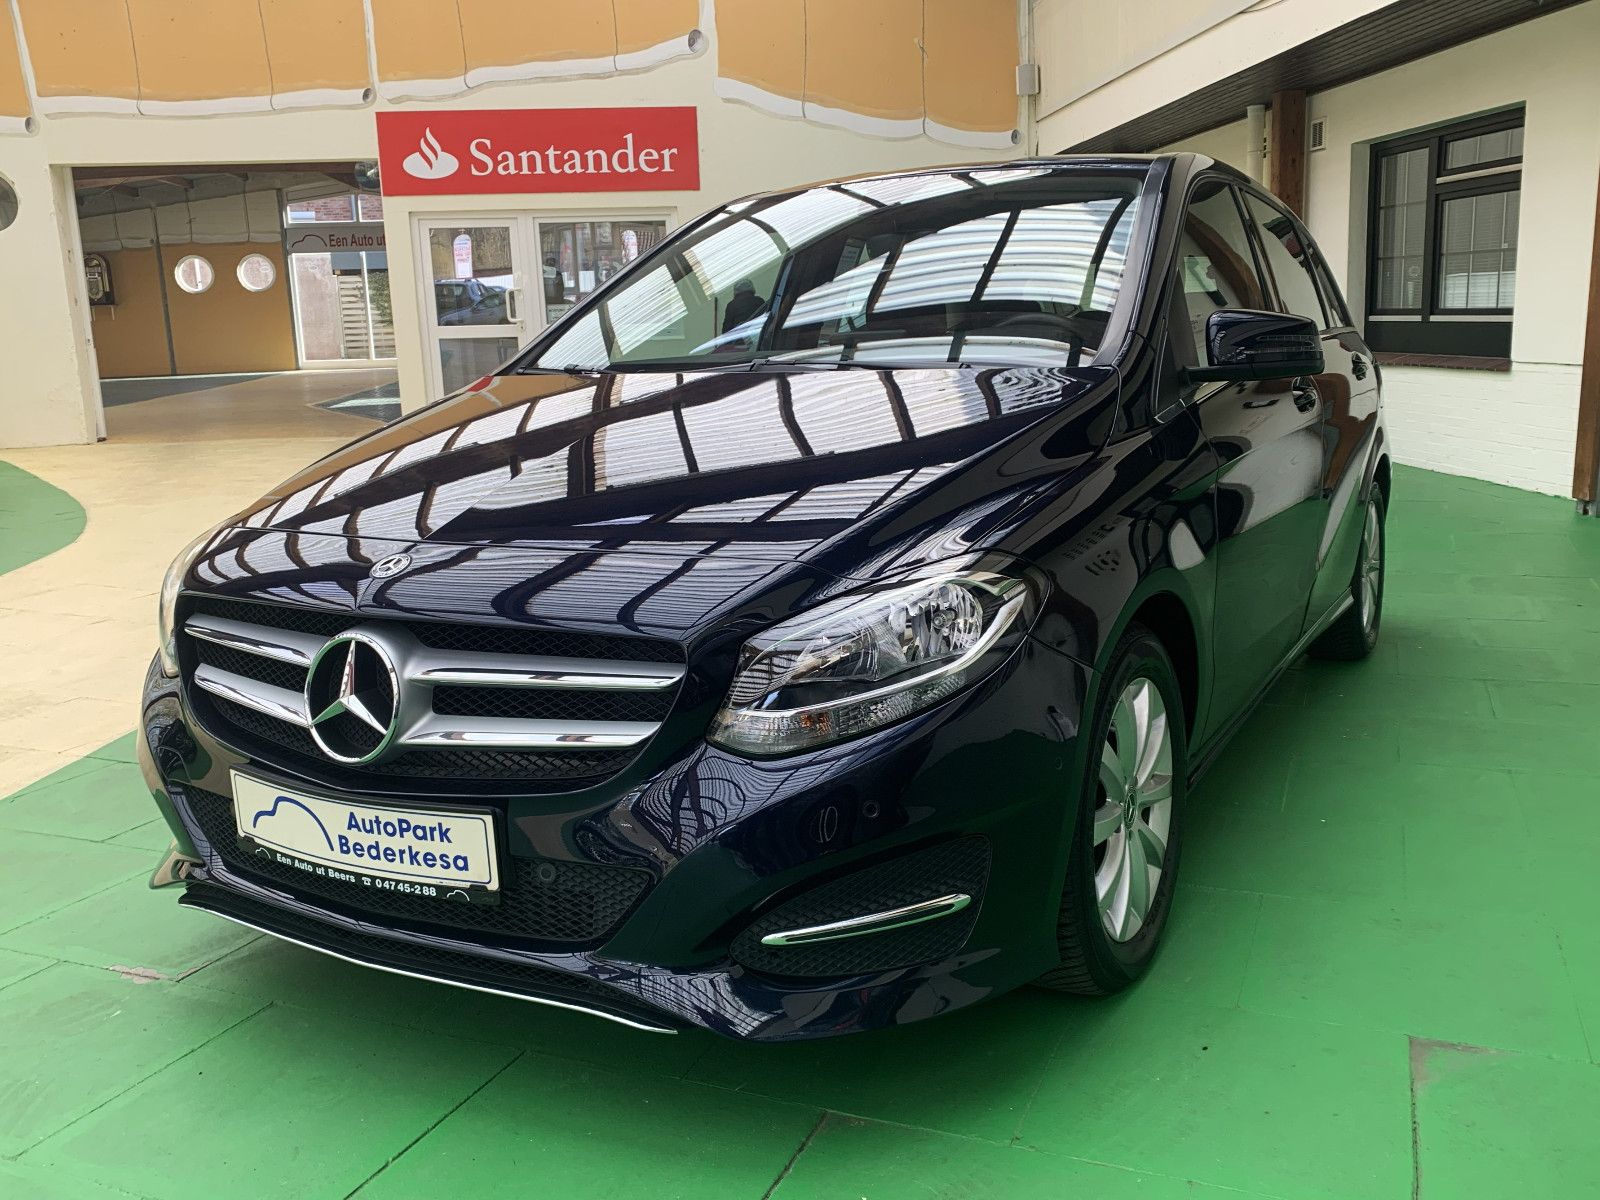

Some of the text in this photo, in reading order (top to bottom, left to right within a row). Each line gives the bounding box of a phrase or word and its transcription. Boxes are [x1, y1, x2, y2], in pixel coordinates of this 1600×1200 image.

[469, 133, 678, 176] Santander
[328, 234, 348, 248] Een
[350, 234, 374, 247] Auto
[347, 811, 453, 844] AutoPark
[337, 834, 470, 872] Bederkesa
[276, 853, 292, 866] Een
[294, 859, 314, 873] Auto
[315, 866, 326, 876] ut
[328, 868, 356, 883] Beers
[375, 879, 437, 897] 04745-288
